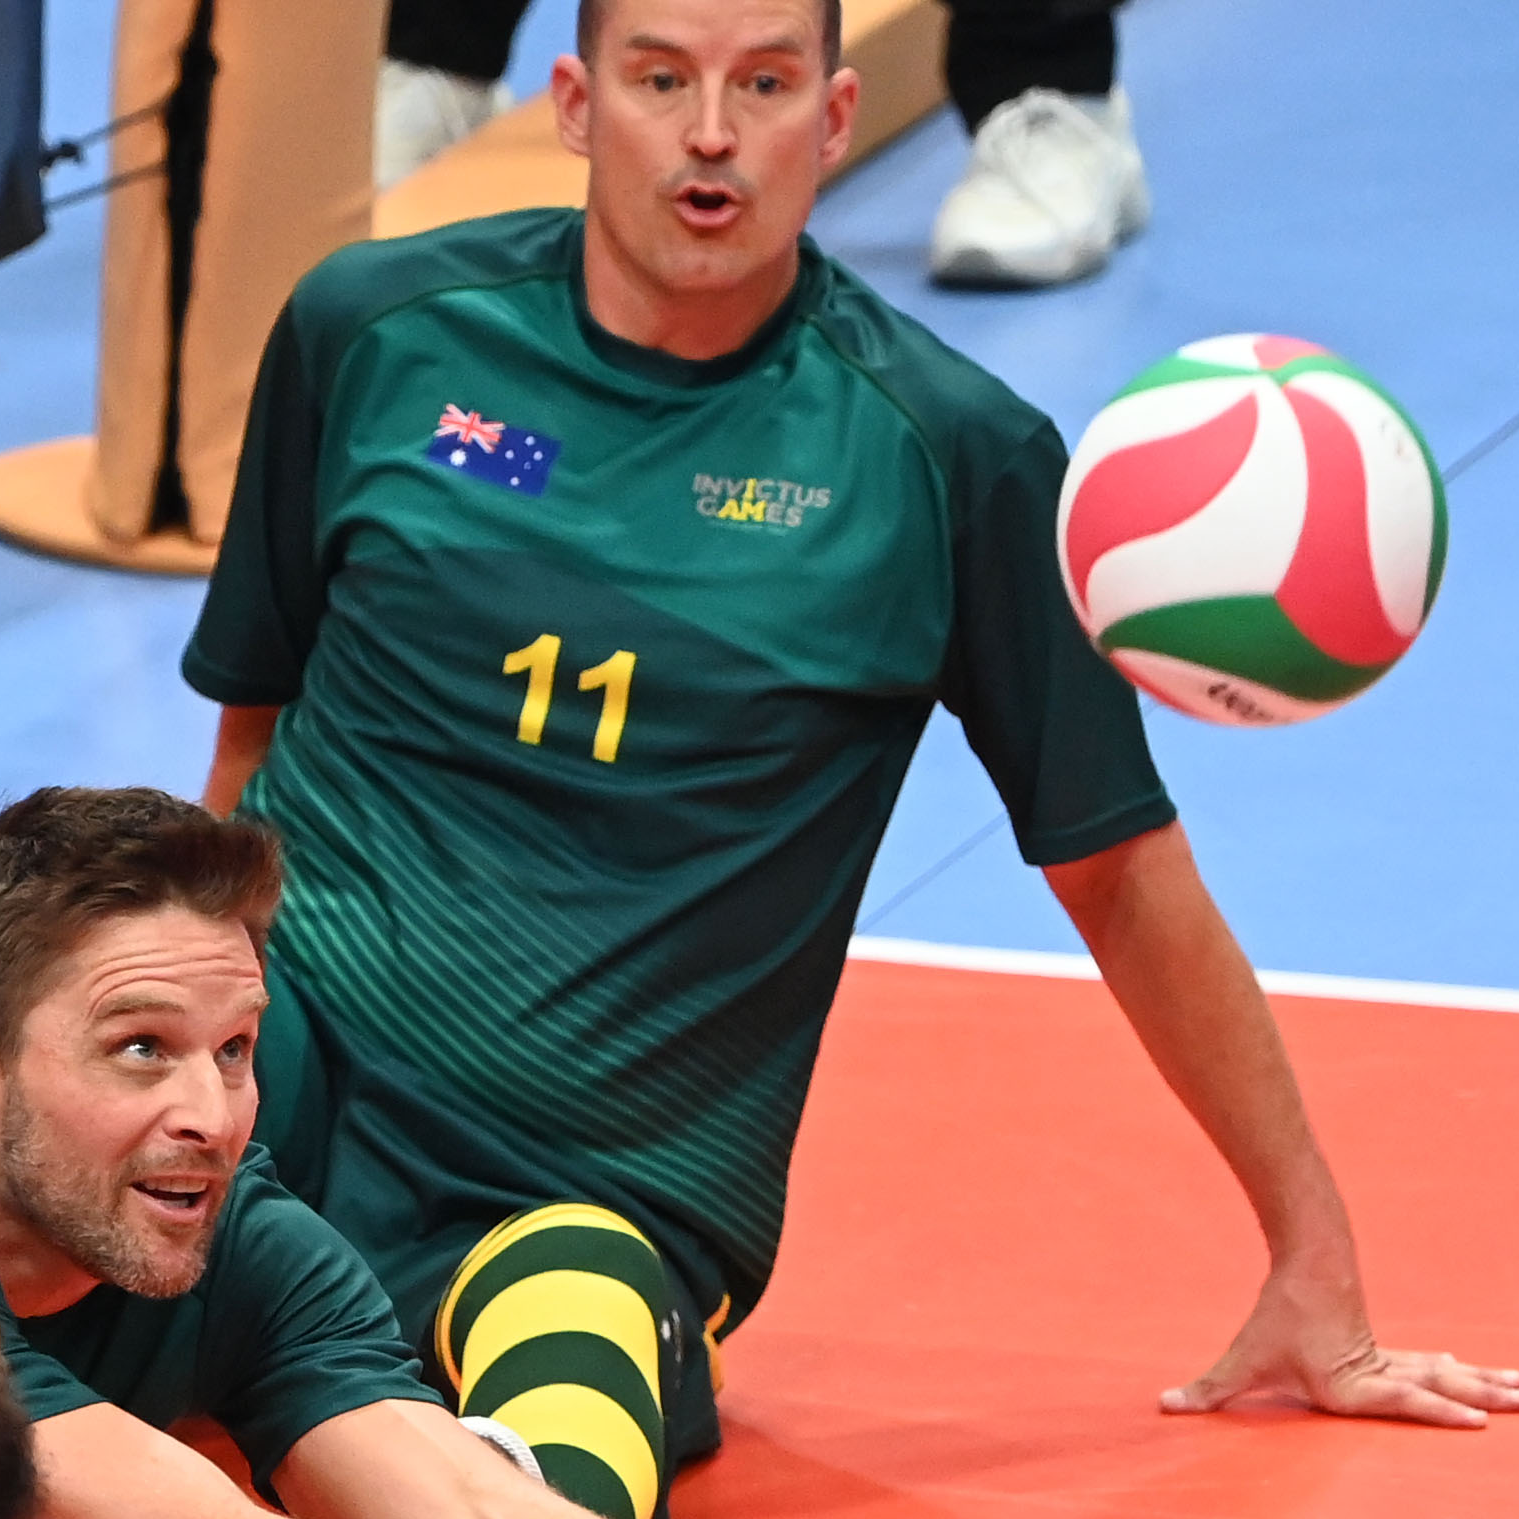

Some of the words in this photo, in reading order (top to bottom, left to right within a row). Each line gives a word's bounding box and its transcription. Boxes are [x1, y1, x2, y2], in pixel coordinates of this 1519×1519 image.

[692, 473, 831, 508] INVICTUS
[696, 495, 804, 527] GAMES
[502, 633, 638, 764] 11
